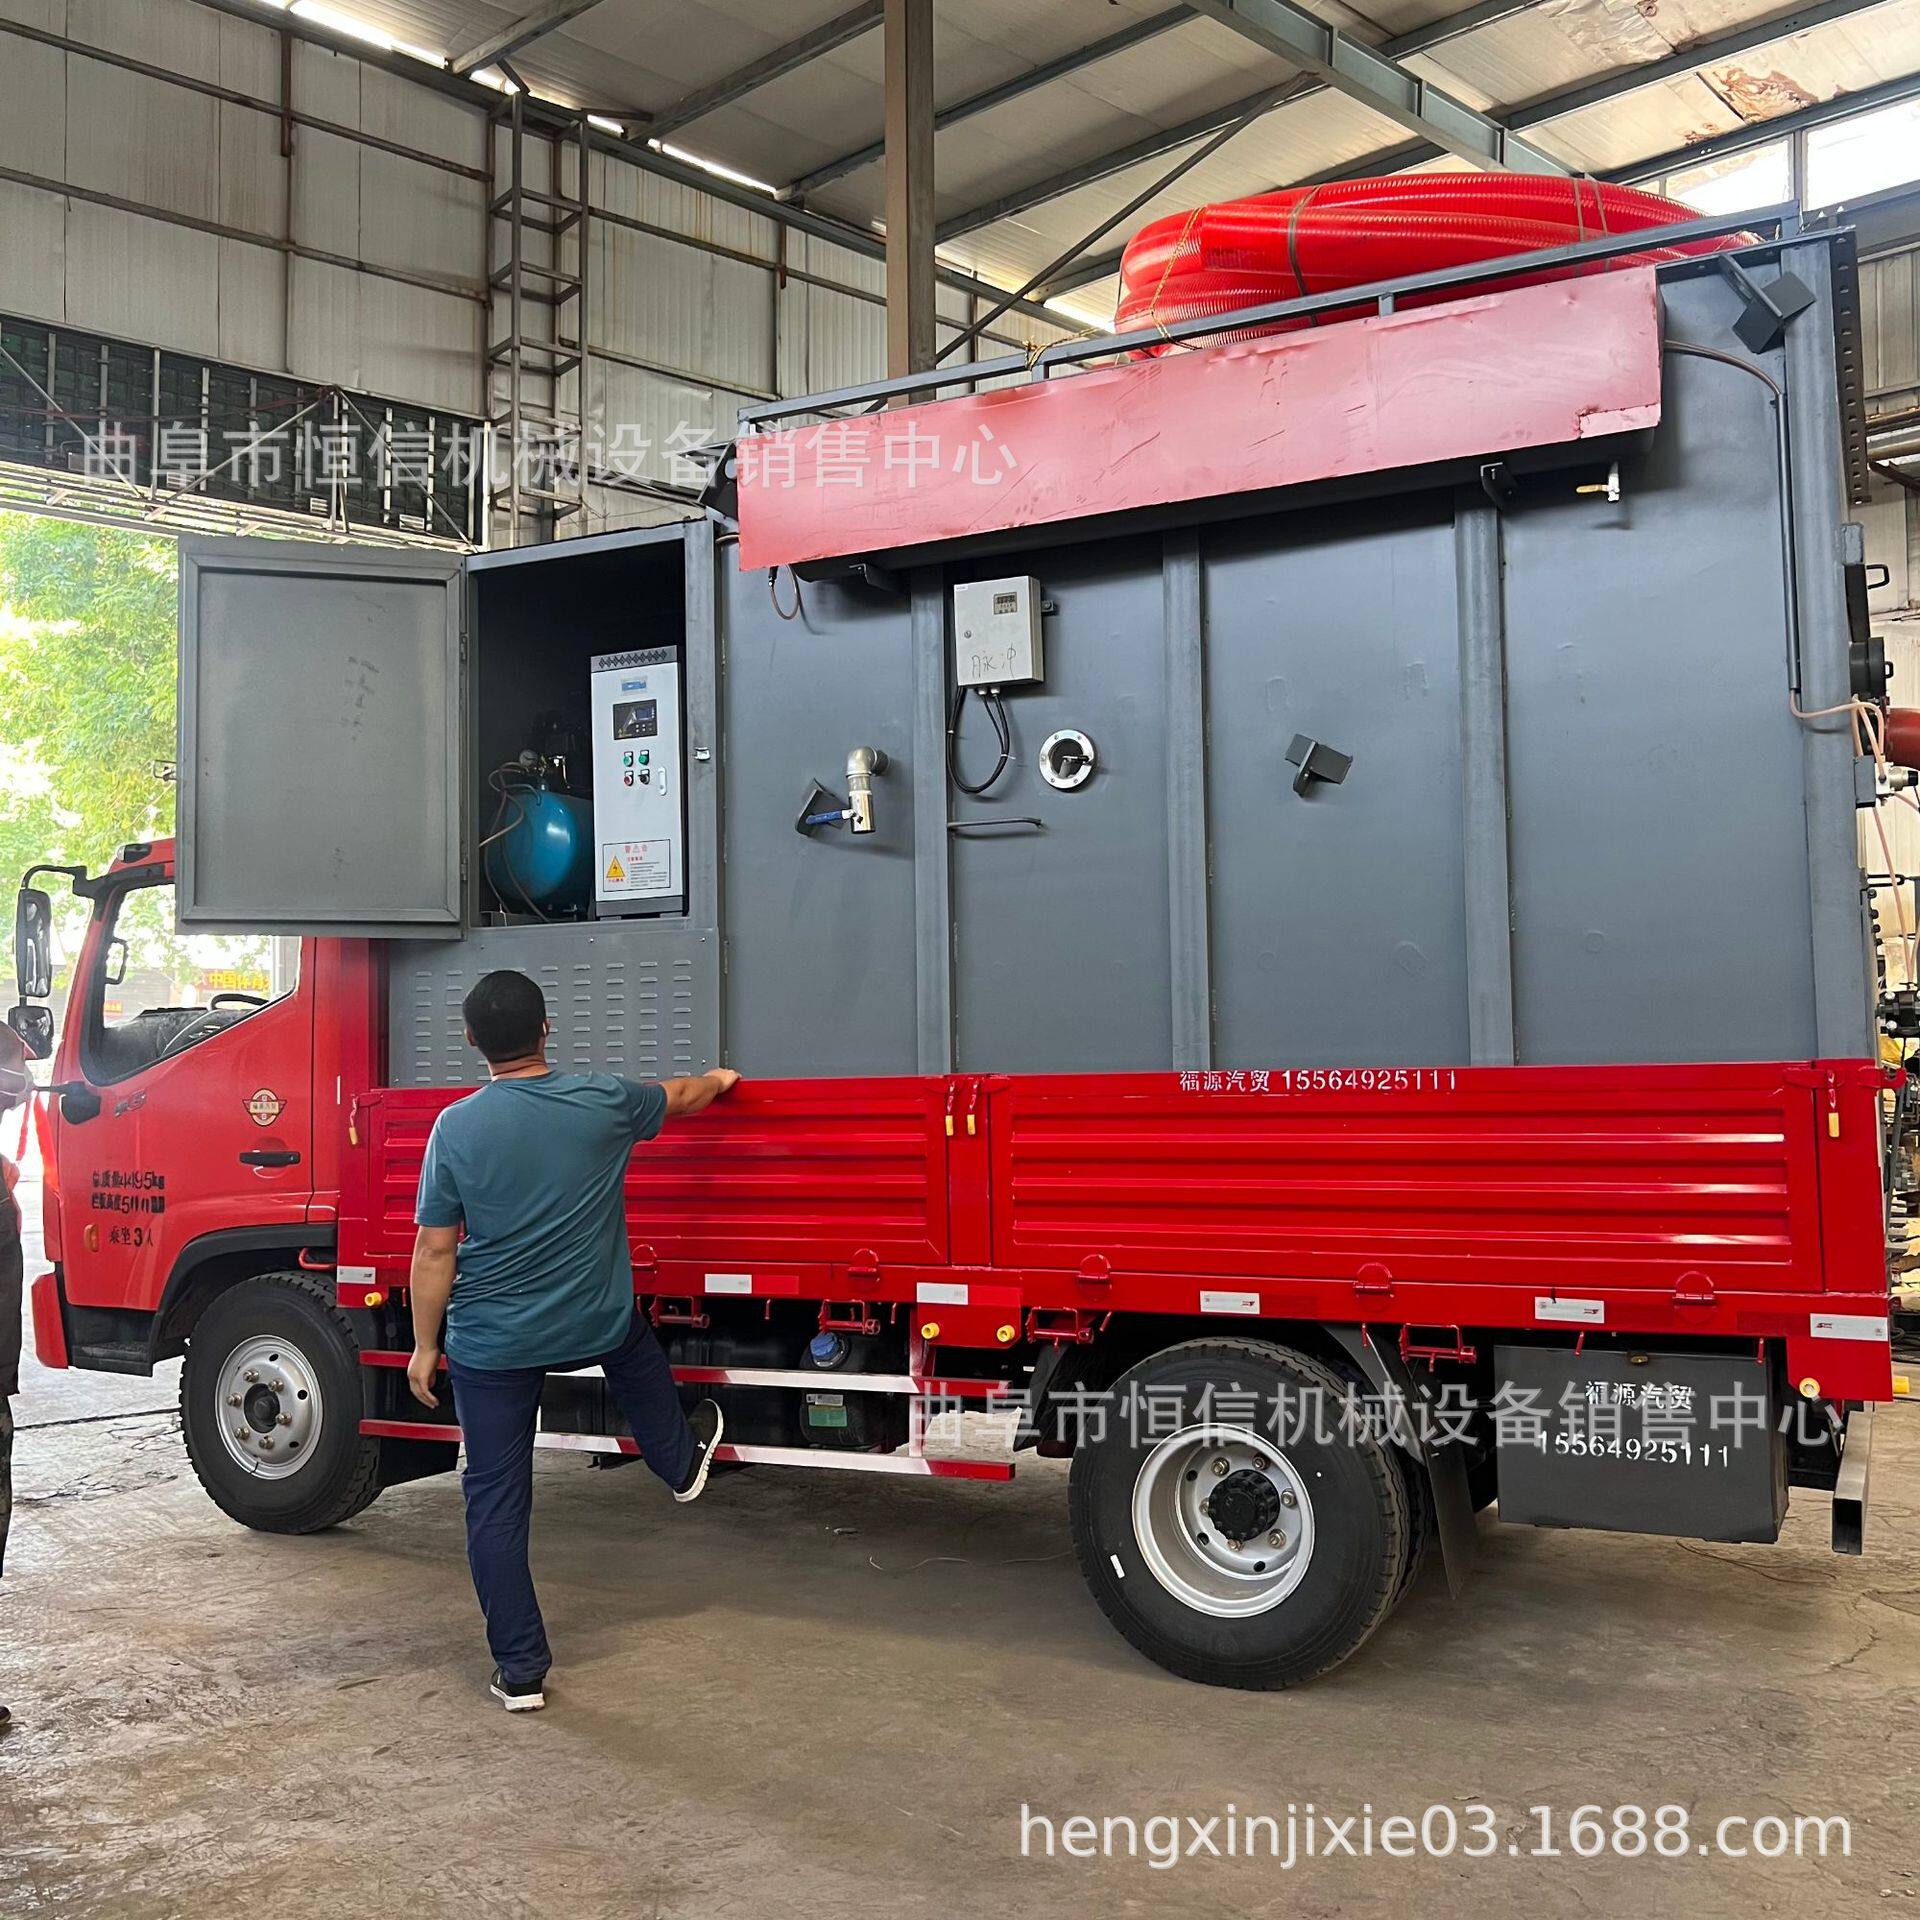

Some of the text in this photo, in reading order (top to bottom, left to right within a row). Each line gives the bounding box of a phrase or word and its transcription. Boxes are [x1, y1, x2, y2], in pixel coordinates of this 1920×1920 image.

[1179, 1069, 1457, 1093] 福源汽贸 15564925111
[1538, 1430, 1729, 1468] 15564925111
